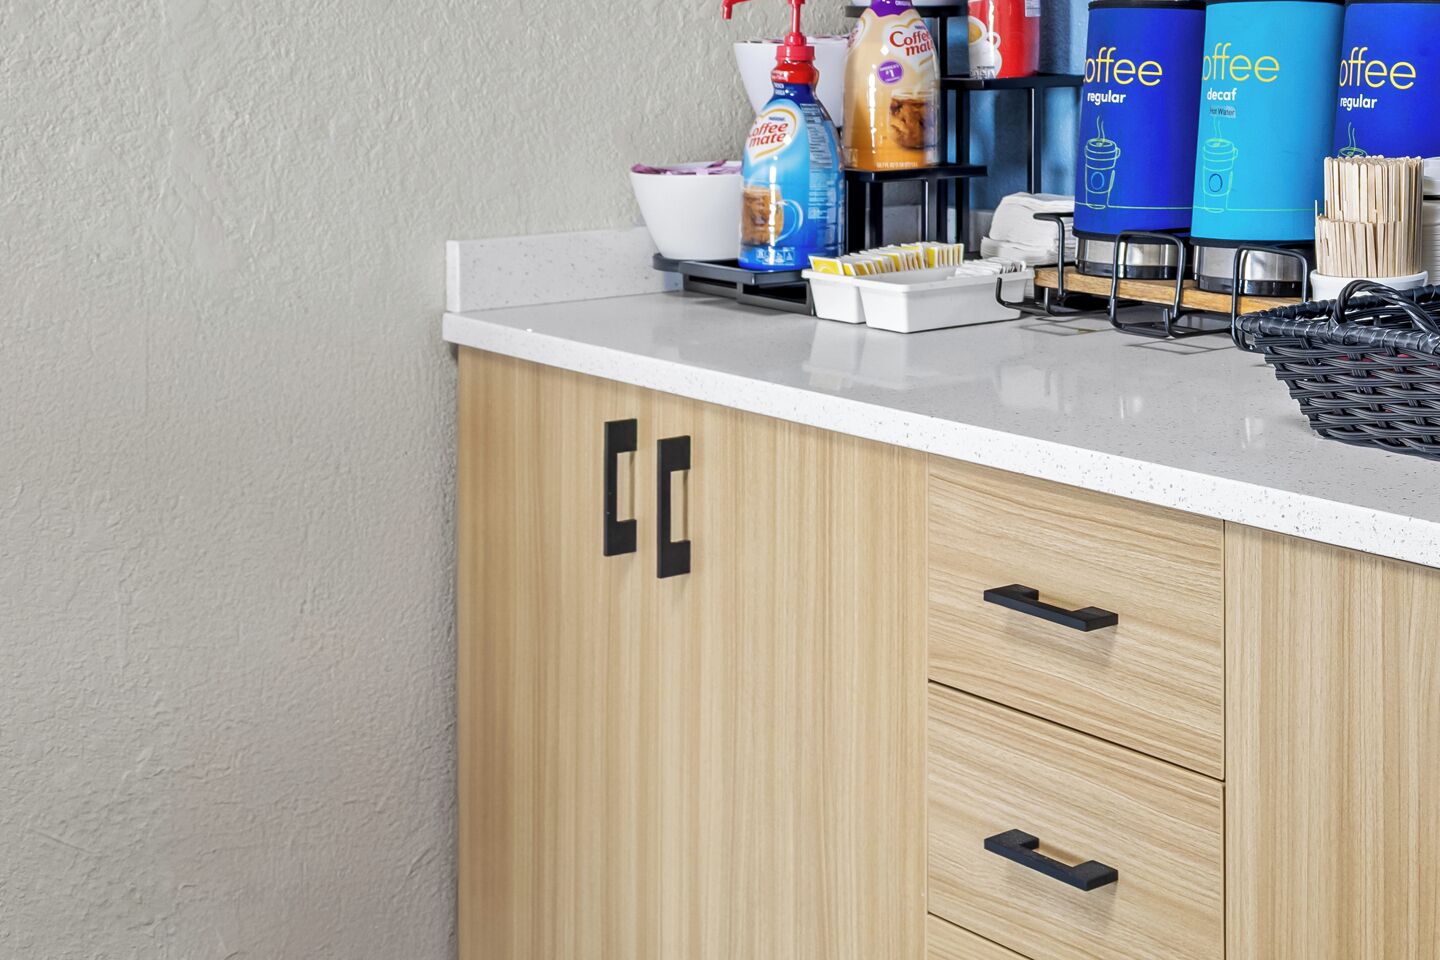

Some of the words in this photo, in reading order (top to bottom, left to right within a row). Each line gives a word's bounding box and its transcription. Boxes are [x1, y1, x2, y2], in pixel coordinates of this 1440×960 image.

[905, 39, 932, 56] mat
[1083, 46, 1163, 87] offee
[1202, 42, 1280, 82] offee
[1339, 46, 1417, 90] offee
[1087, 90, 1127, 106] regular
[1206, 87, 1238, 101] decaf
[1340, 93, 1378, 111] regular
[748, 123, 788, 137] offee
[749, 132, 786, 148] mate
